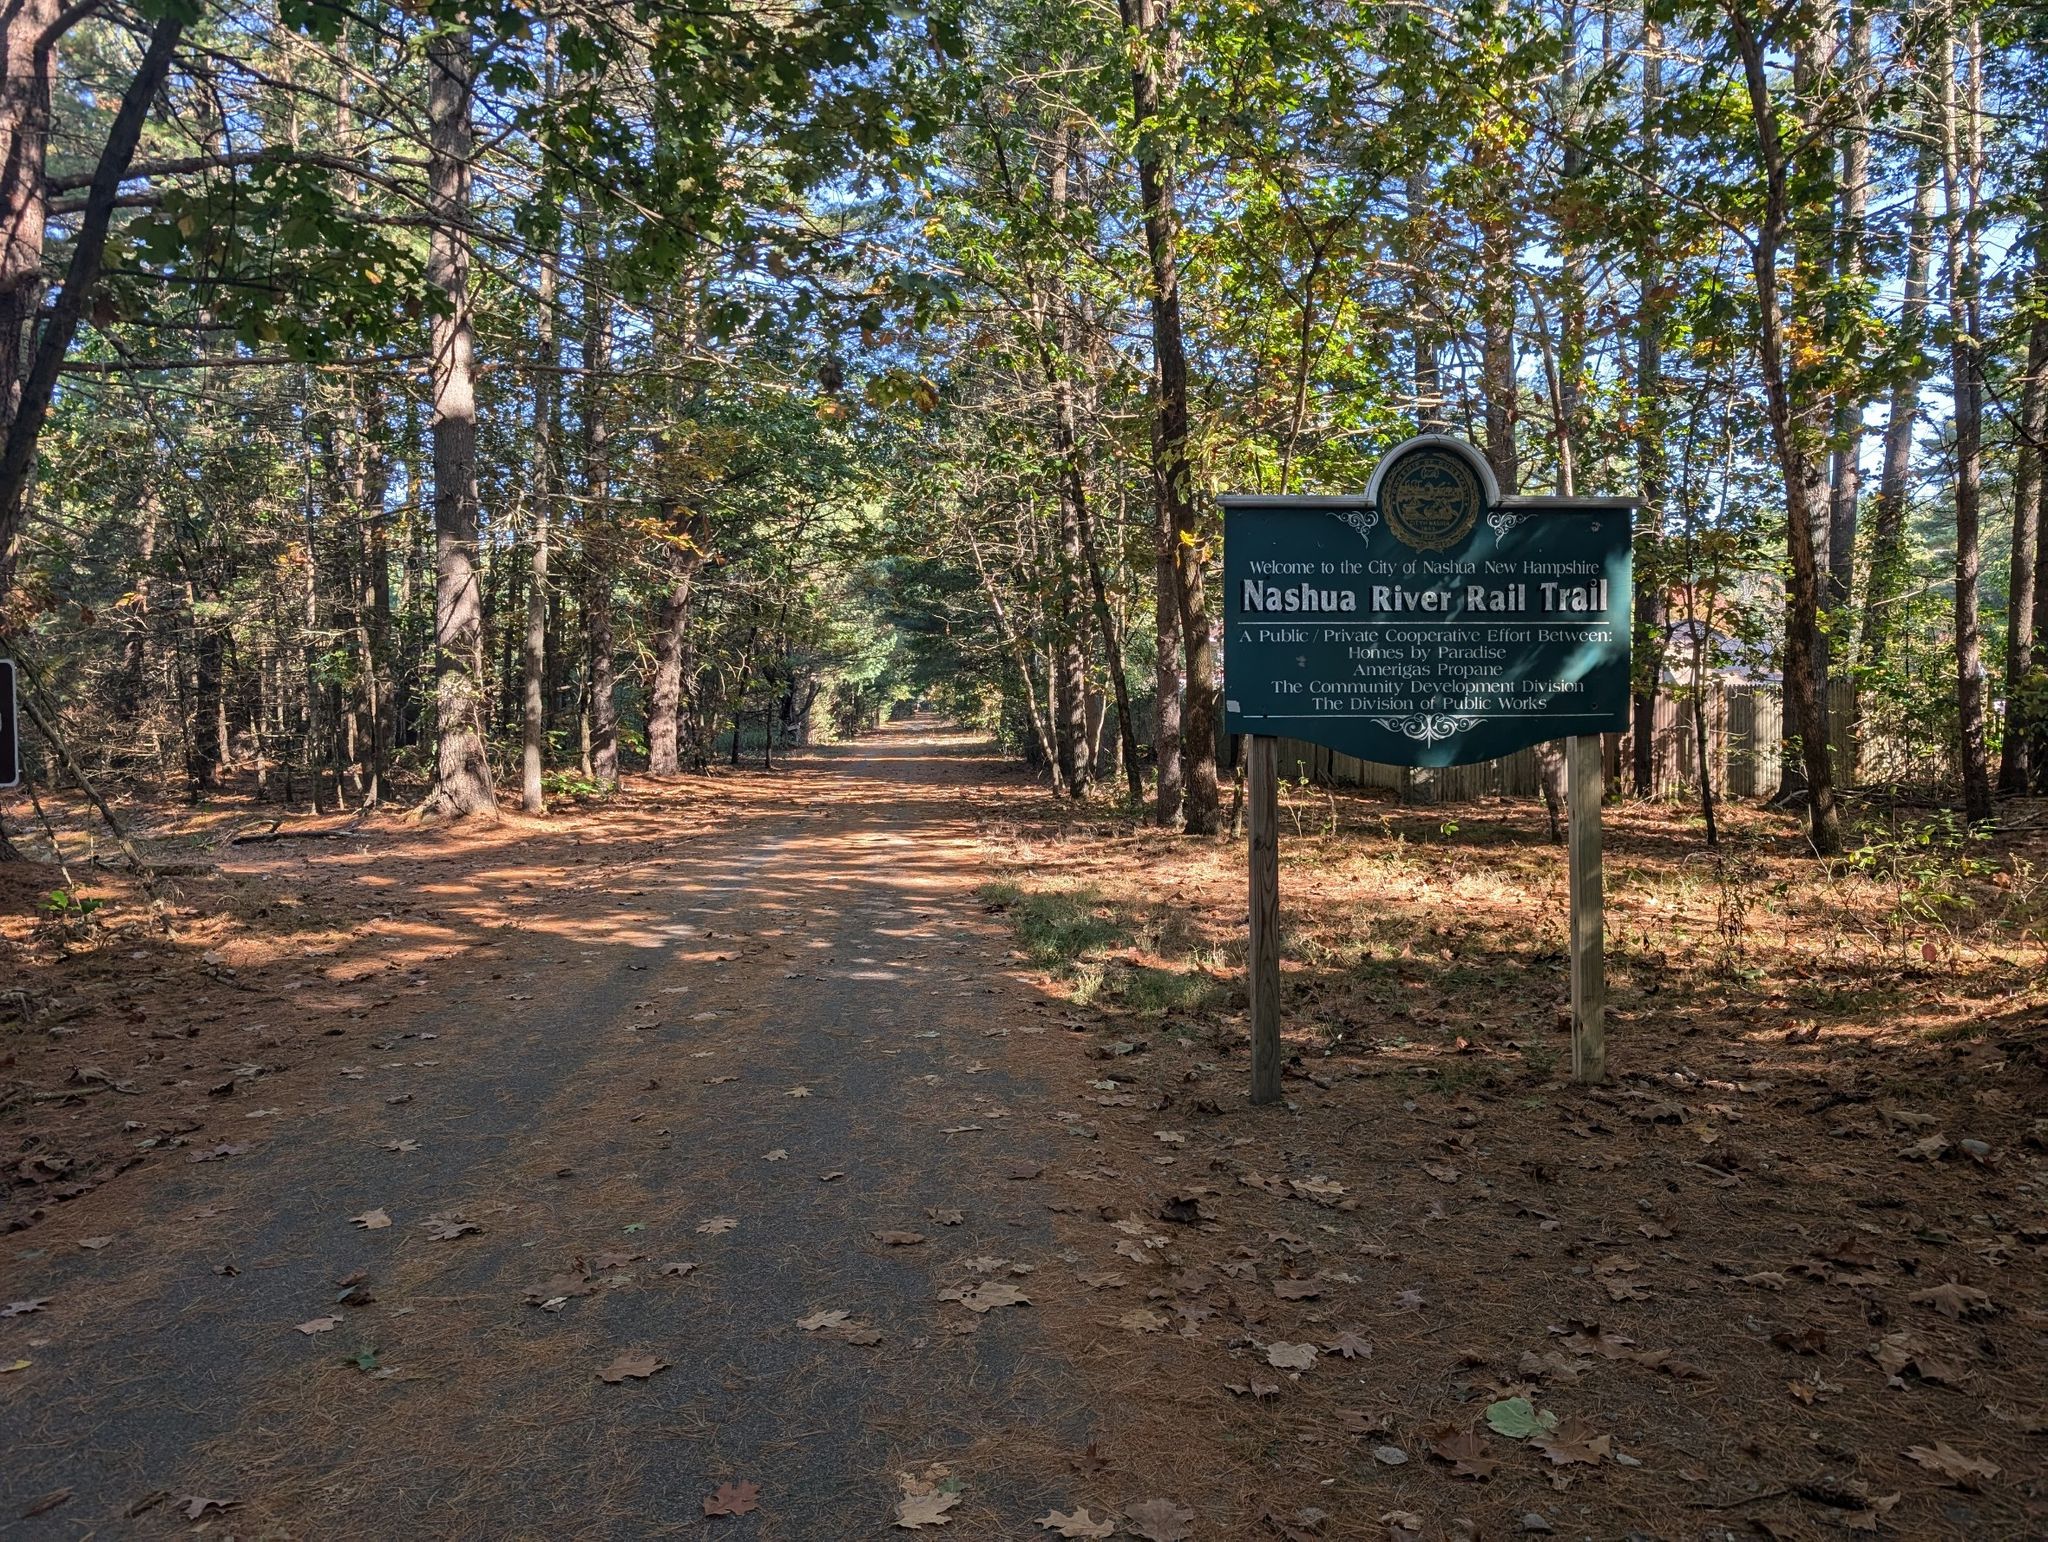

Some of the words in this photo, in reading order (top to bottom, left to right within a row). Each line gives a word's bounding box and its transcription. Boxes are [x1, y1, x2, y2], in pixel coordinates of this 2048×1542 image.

[1249, 560, 1315, 575] Welcome
[1321, 561, 1334, 575] to
[1340, 560, 1362, 575] the
[1368, 560, 1397, 577] City
[1402, 560, 1417, 575] of
[1423, 560, 1476, 575] Nashua
[1485, 560, 1517, 575] New
[1523, 560, 1600, 577] Hampshire
[1242, 579, 1357, 612] Nashua
[1370, 584, 1452, 612] River
[1466, 583, 1526, 612] Rail
[1539, 578, 1608, 612] Trail
[1239, 629, 1252, 643] A
[1259, 629, 1309, 643] Public
[1323, 629, 1379, 643] Private
[1385, 628, 1481, 646] Cooperative
[1487, 628, 1531, 643] Effort
[1538, 628, 1613, 643] Between:
[1349, 646, 1404, 660] Homes
[1411, 646, 1431, 662] by
[1438, 645, 1507, 660] Paradise
[1353, 663, 1431, 679] Amerigas
[1438, 663, 1503, 679] Propane
[1271, 680, 1303, 694] The
[1309, 680, 1404, 696] Community
[1411, 679, 1515, 696] Development
[1522, 679, 1585, 693] Division
[1312, 697, 1343, 711] The
[1350, 697, 1414, 711] Division
[1420, 696, 1437, 710] of
[1443, 697, 1492, 711] Public
[1498, 697, 1547, 711] Works
